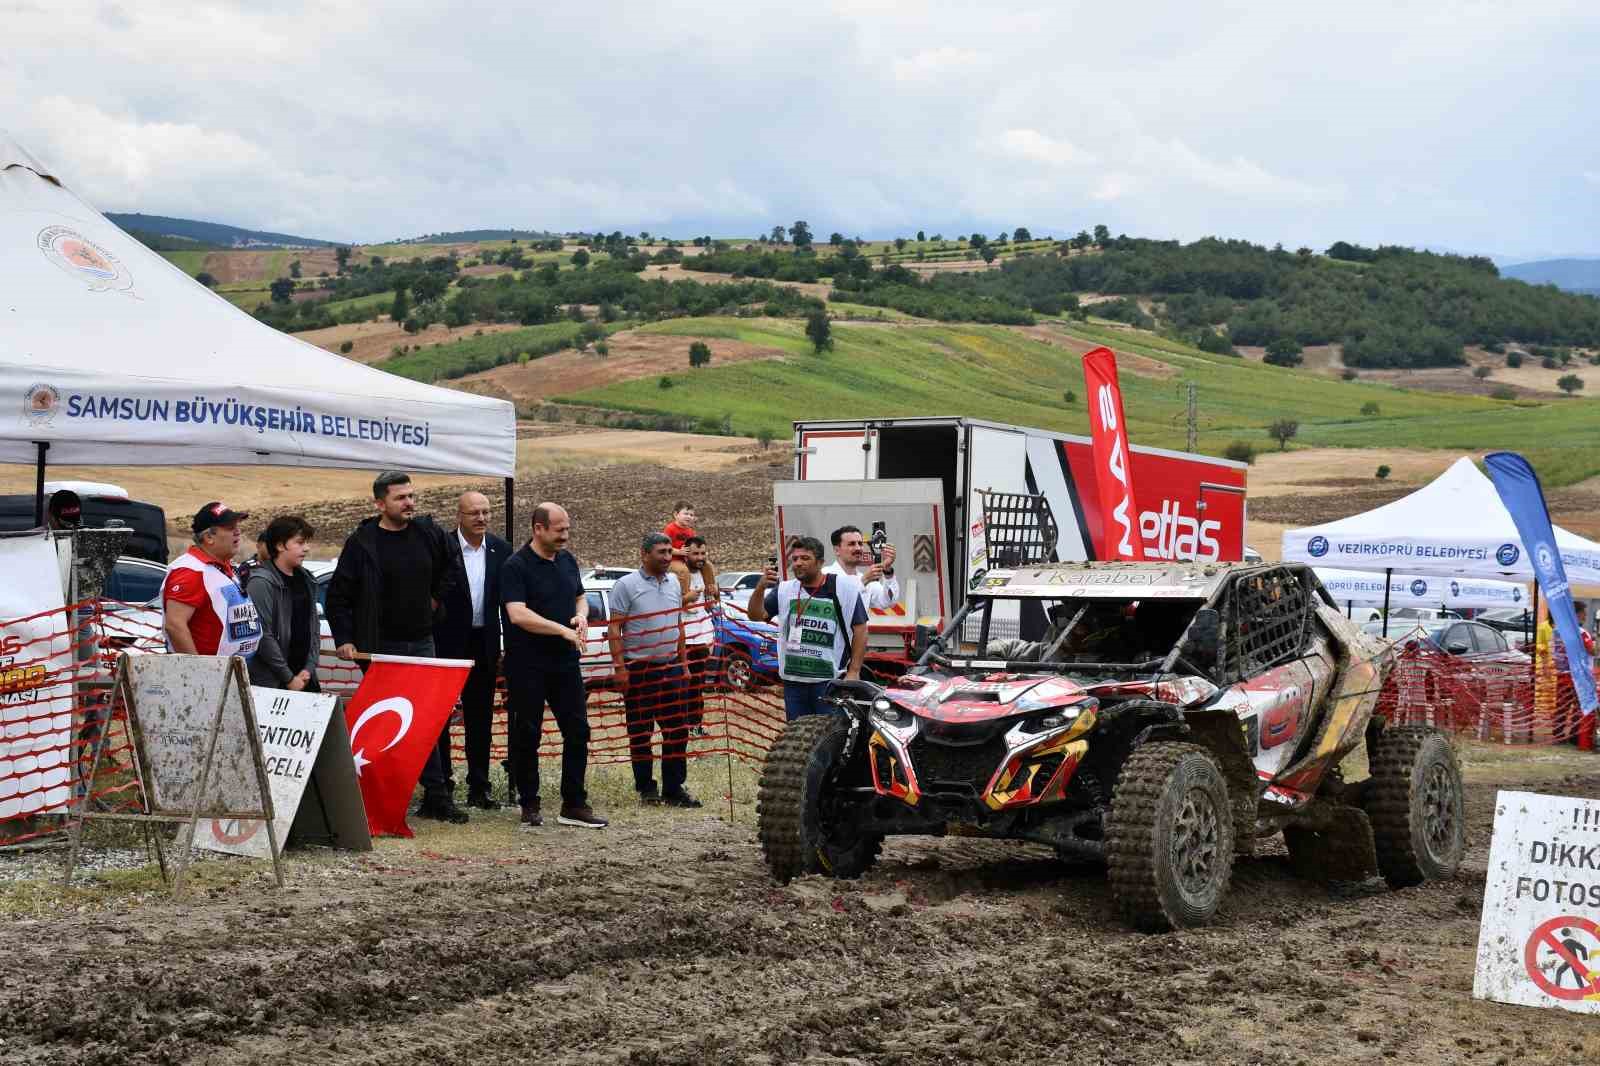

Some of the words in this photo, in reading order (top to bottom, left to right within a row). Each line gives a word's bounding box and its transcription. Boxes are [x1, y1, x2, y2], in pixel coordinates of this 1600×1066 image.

[66, 394, 170, 422] SAMSUN
[175, 396, 317, 433] BÜYÜKŞEHİR
[321, 414, 431, 446] BELEDİYESİ
[1138, 499, 1221, 561] etlas
[1337, 542, 1413, 556] VEZİRKÖPRÜ
[1415, 543, 1489, 560] BELEDİYESİ
[795, 617, 829, 631] MEDIA
[801, 631, 828, 643] EDYA
[1530, 836, 1600, 871] DİKK
